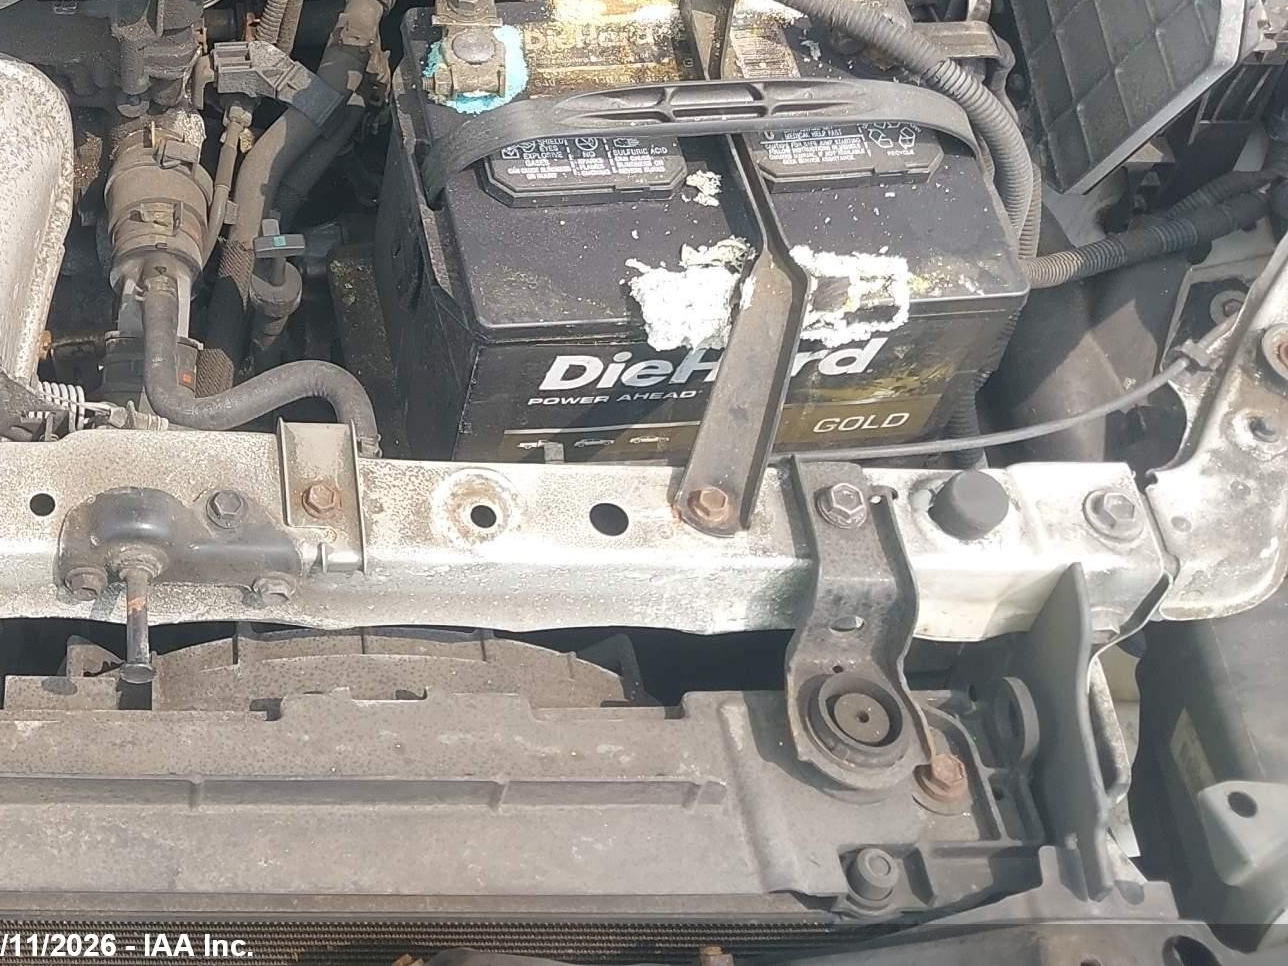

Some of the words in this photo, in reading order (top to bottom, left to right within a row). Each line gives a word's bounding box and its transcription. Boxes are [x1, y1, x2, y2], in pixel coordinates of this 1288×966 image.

[523, 151, 563, 160] EXPLOSIVE
[613, 147, 649, 156] SULFURIC
[650, 146, 668, 155] ACID
[539, 338, 888, 391] DieHrd
[528, 396, 609, 405] POWER
[616, 390, 697, 403] AHEAD
[812, 412, 910, 434] GOLD
